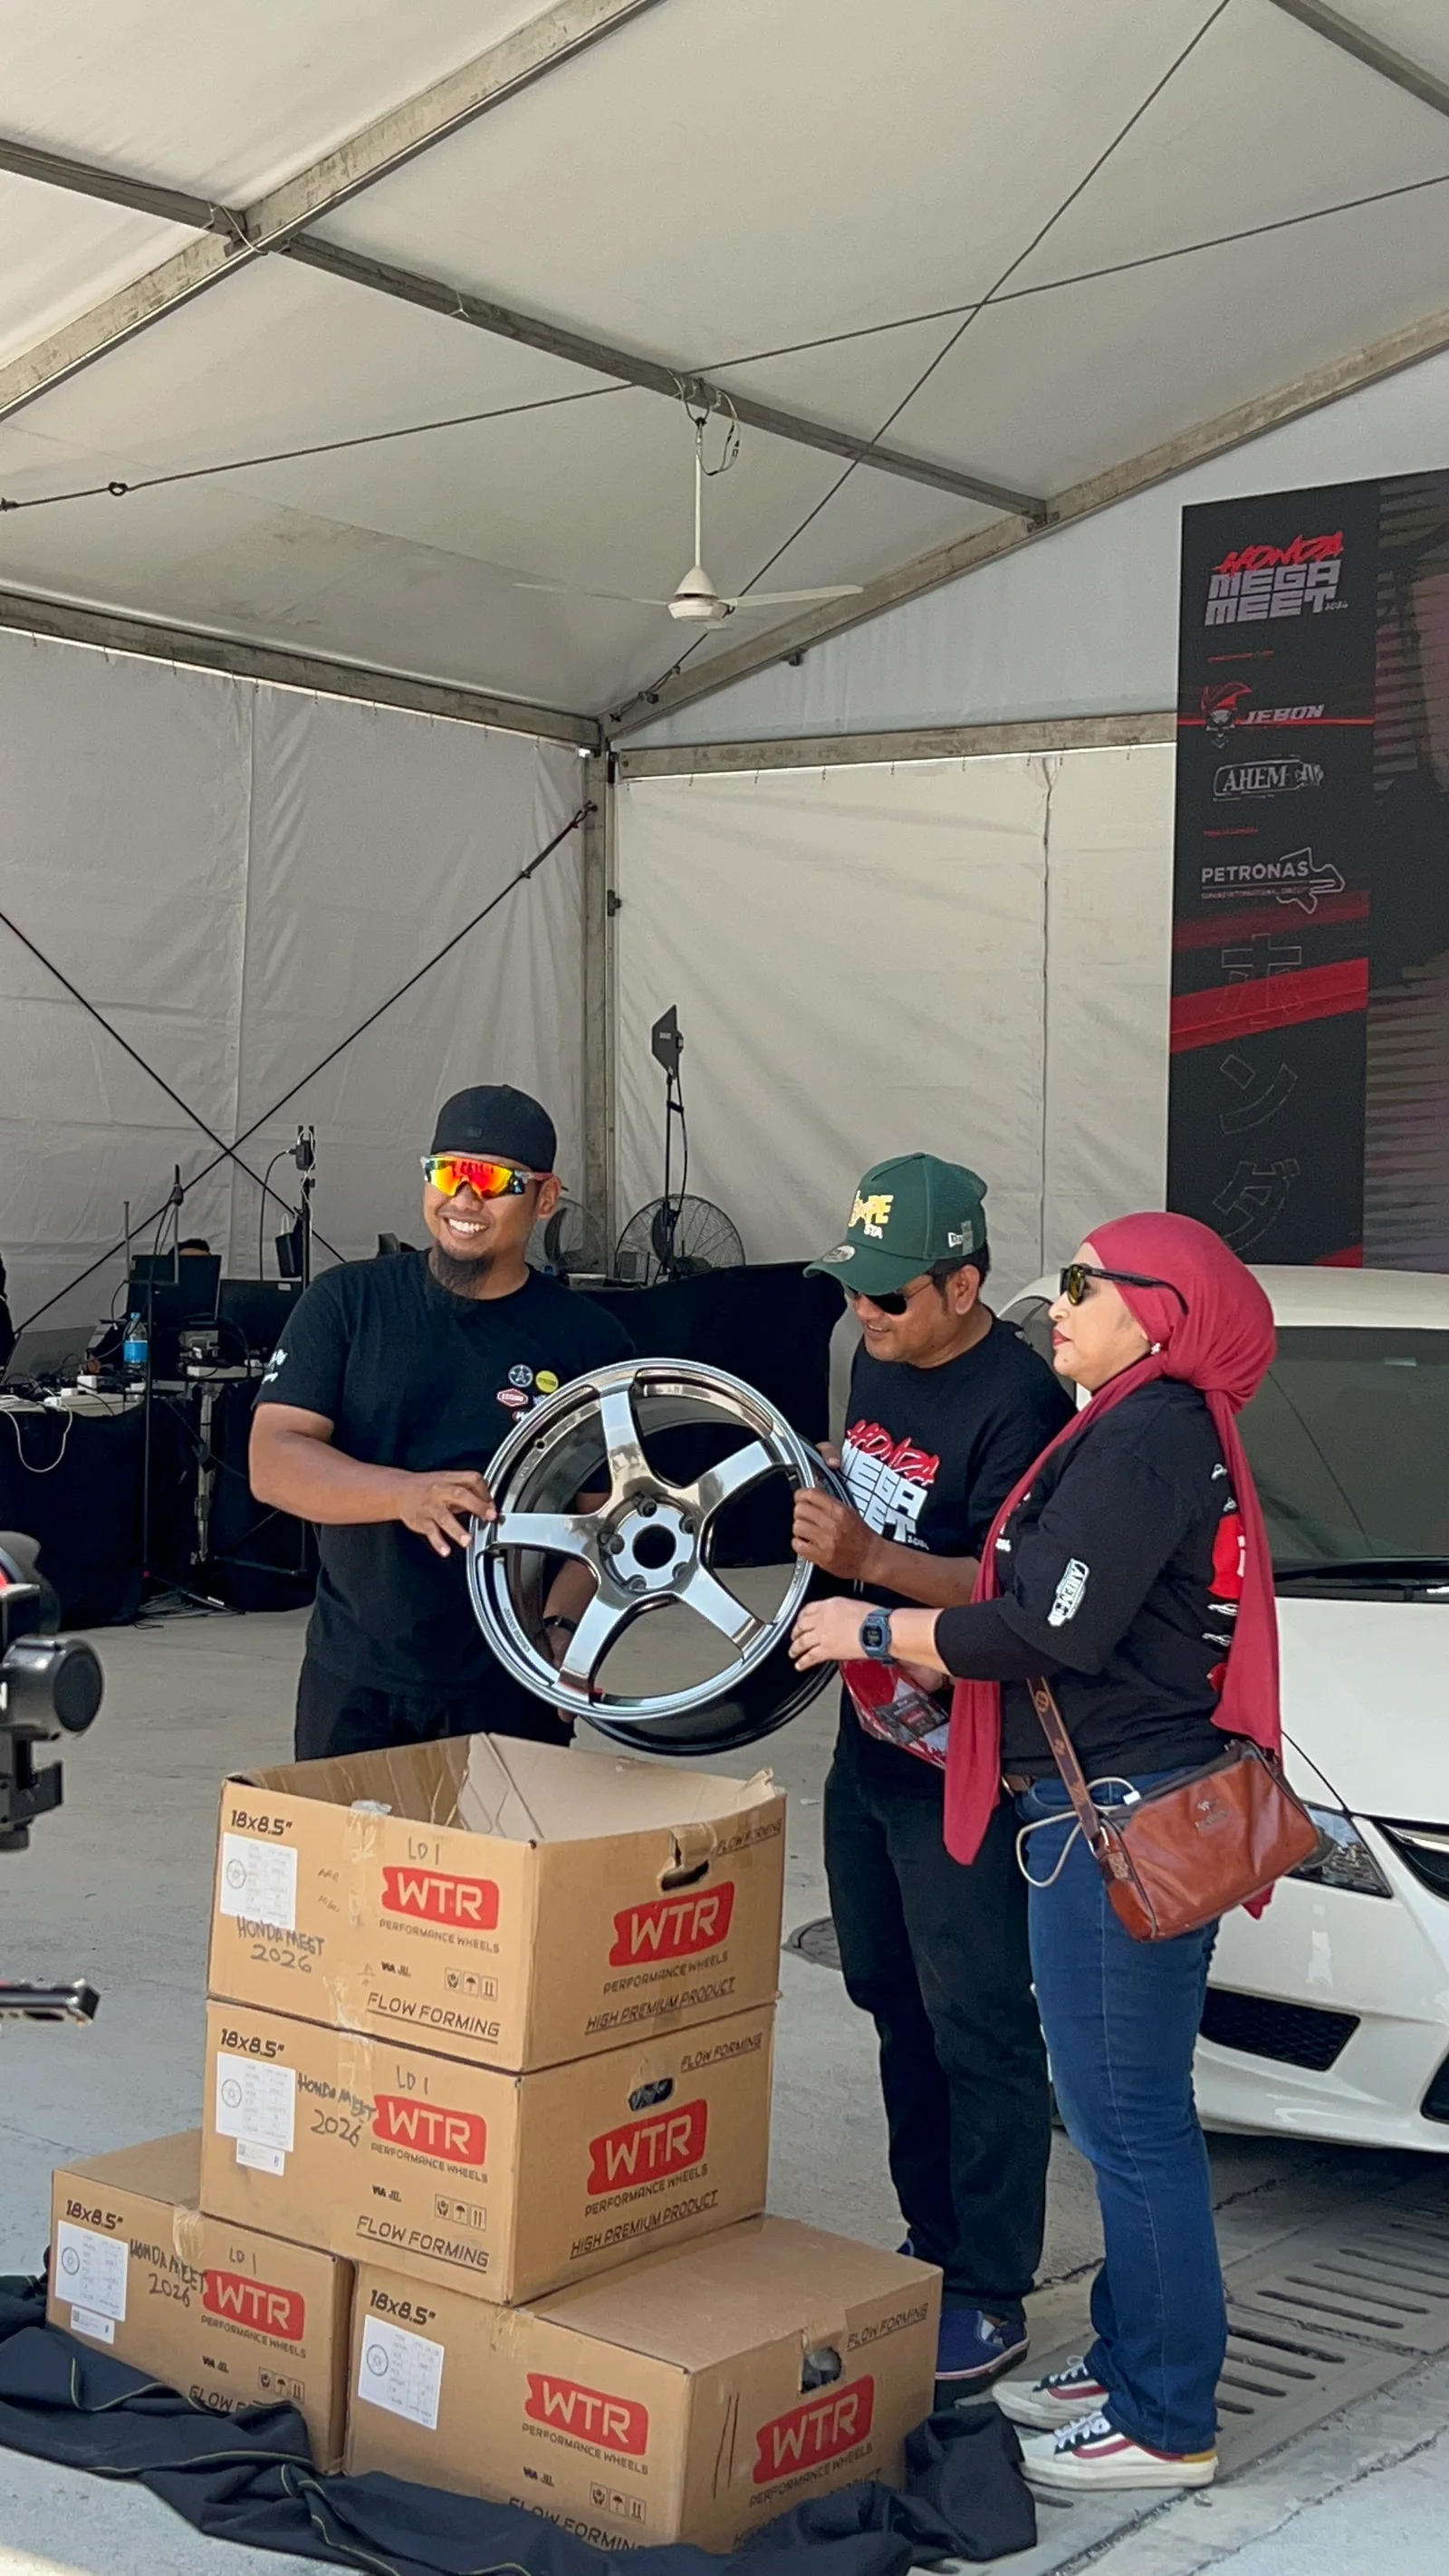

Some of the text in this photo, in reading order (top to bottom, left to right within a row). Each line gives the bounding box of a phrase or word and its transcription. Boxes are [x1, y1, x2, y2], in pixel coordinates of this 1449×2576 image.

[1208, 560, 1341, 600] MEGA
[1204, 585, 1337, 626] MEET
[1242, 704, 1325, 725] JEBON
[1223, 764, 1288, 792] AHEM
[1201, 860, 1310, 883] PETRONAS
[840, 1438, 928, 1520] MEGA
[847, 1481, 917, 1543] EET
[398, 1871, 483, 1920] WTR
[237, 1914, 283, 1943] HONDA
[379, 1918, 500, 1954] PERFORMANCE WHEELS
[631, 1898, 719, 1955] WTR
[250, 1944, 312, 1973] 2026
[604, 1950, 728, 1994] PERFORMANCE WHEELS
[367, 1992, 501, 2037] FLOW FORMING
[586, 1976, 735, 2032] HIGH PREMIUM PRODUCT
[681, 2033, 763, 2069] FLOW FORMING
[311, 2109, 361, 2148] 2026
[389, 2100, 471, 2156] WTR
[606, 2114, 692, 2181] WTR
[370, 2143, 489, 2184] PERFORMANCE WHEELS
[585, 2163, 708, 2217] PERFORMANCE WHEELS
[356, 2216, 489, 2267] FLOW FORMING
[571, 2190, 719, 2257] HIGH PREMIUM PRODUCT
[149, 2273, 190, 2307] 2026
[216, 2275, 291, 2330] WTR
[201, 2315, 307, 2359] PERFORMANCE WHEELS
[543, 2381, 631, 2444] WTR
[773, 2393, 858, 2468] WTR
[522, 2423, 648, 2475] PERFORMANCE WHEELS
[749, 2464, 830, 2508] PERFORMANCE
[564, 2518, 635, 2550] FORMIN
